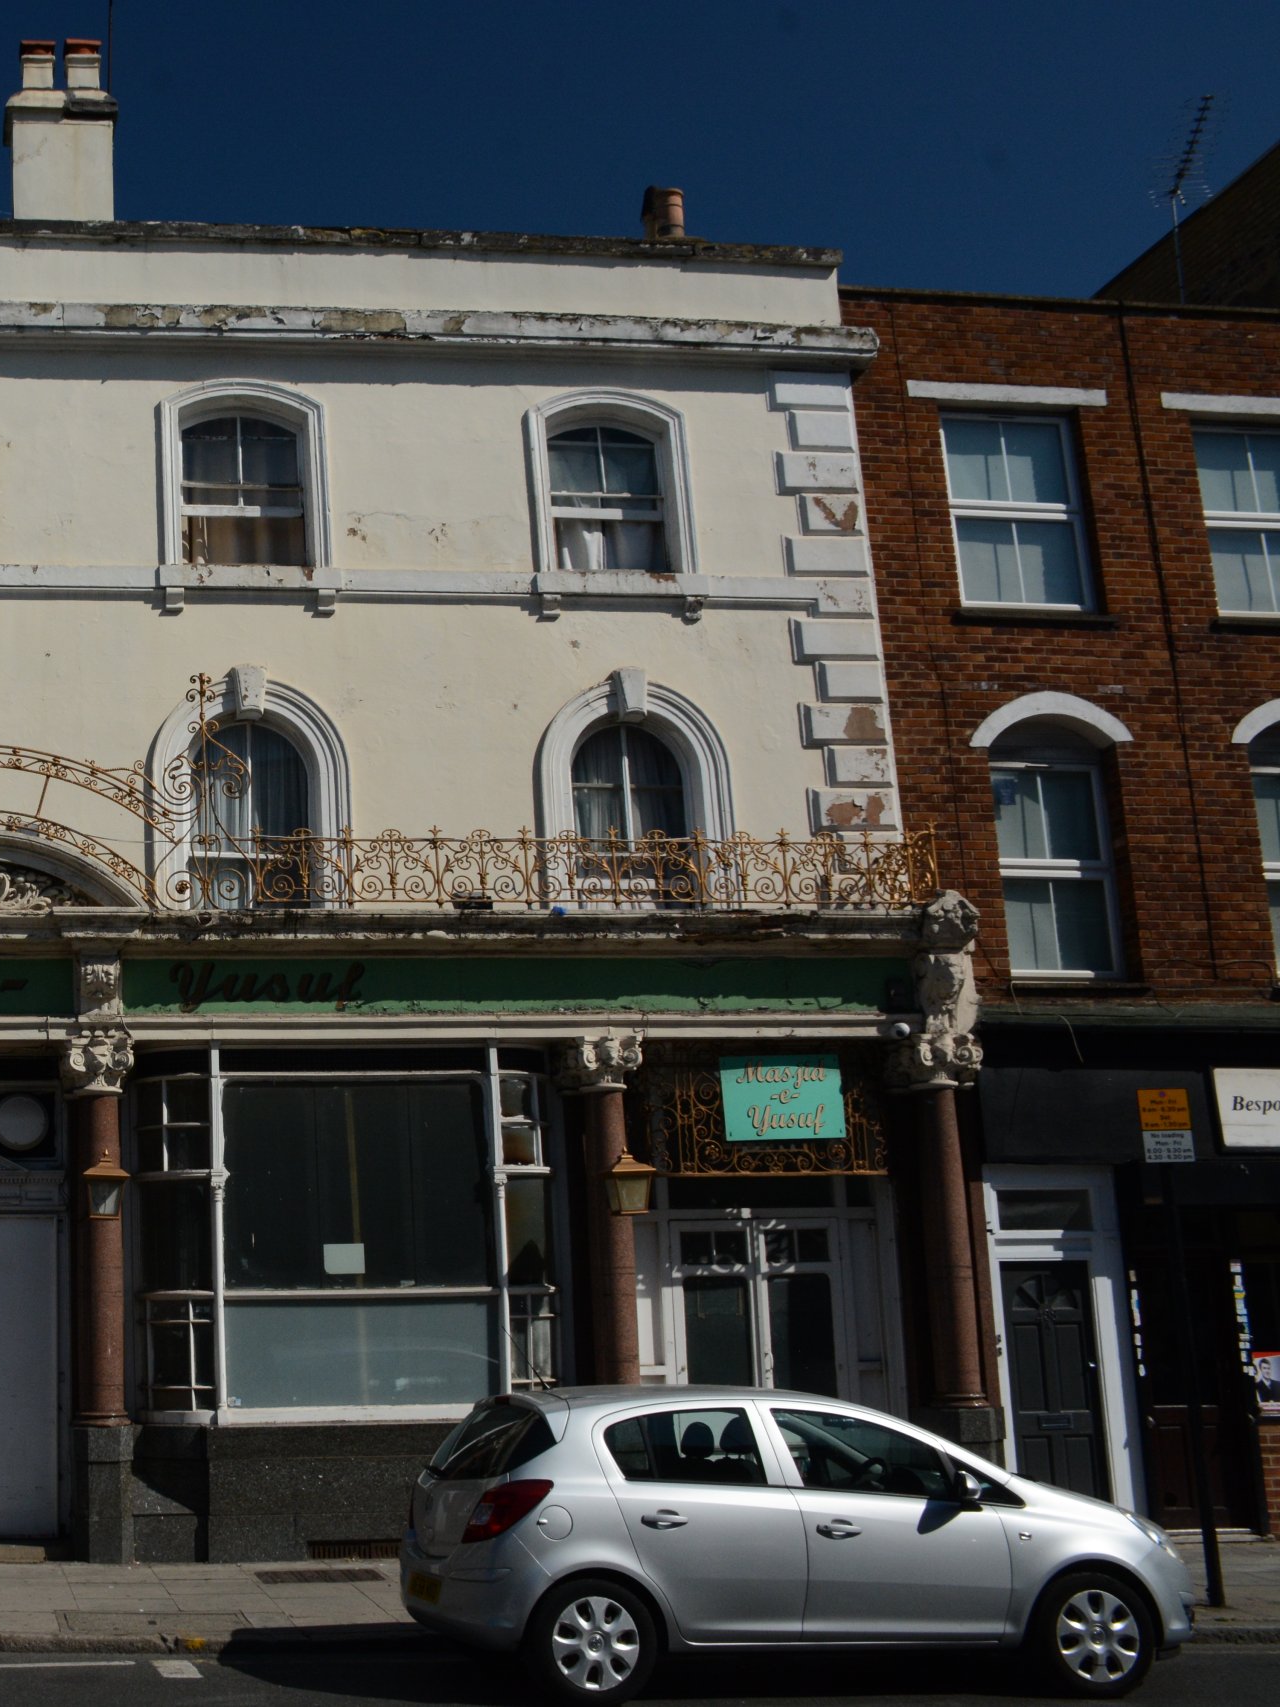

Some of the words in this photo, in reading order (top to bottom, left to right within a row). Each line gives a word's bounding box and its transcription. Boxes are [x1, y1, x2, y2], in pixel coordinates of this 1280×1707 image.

[170, 961, 365, 1013] Yusuf
[736, 1060, 826, 1089] Masjid
[770, 1089, 800, 1104] -e-
[747, 1103, 825, 1136] Yusuf
